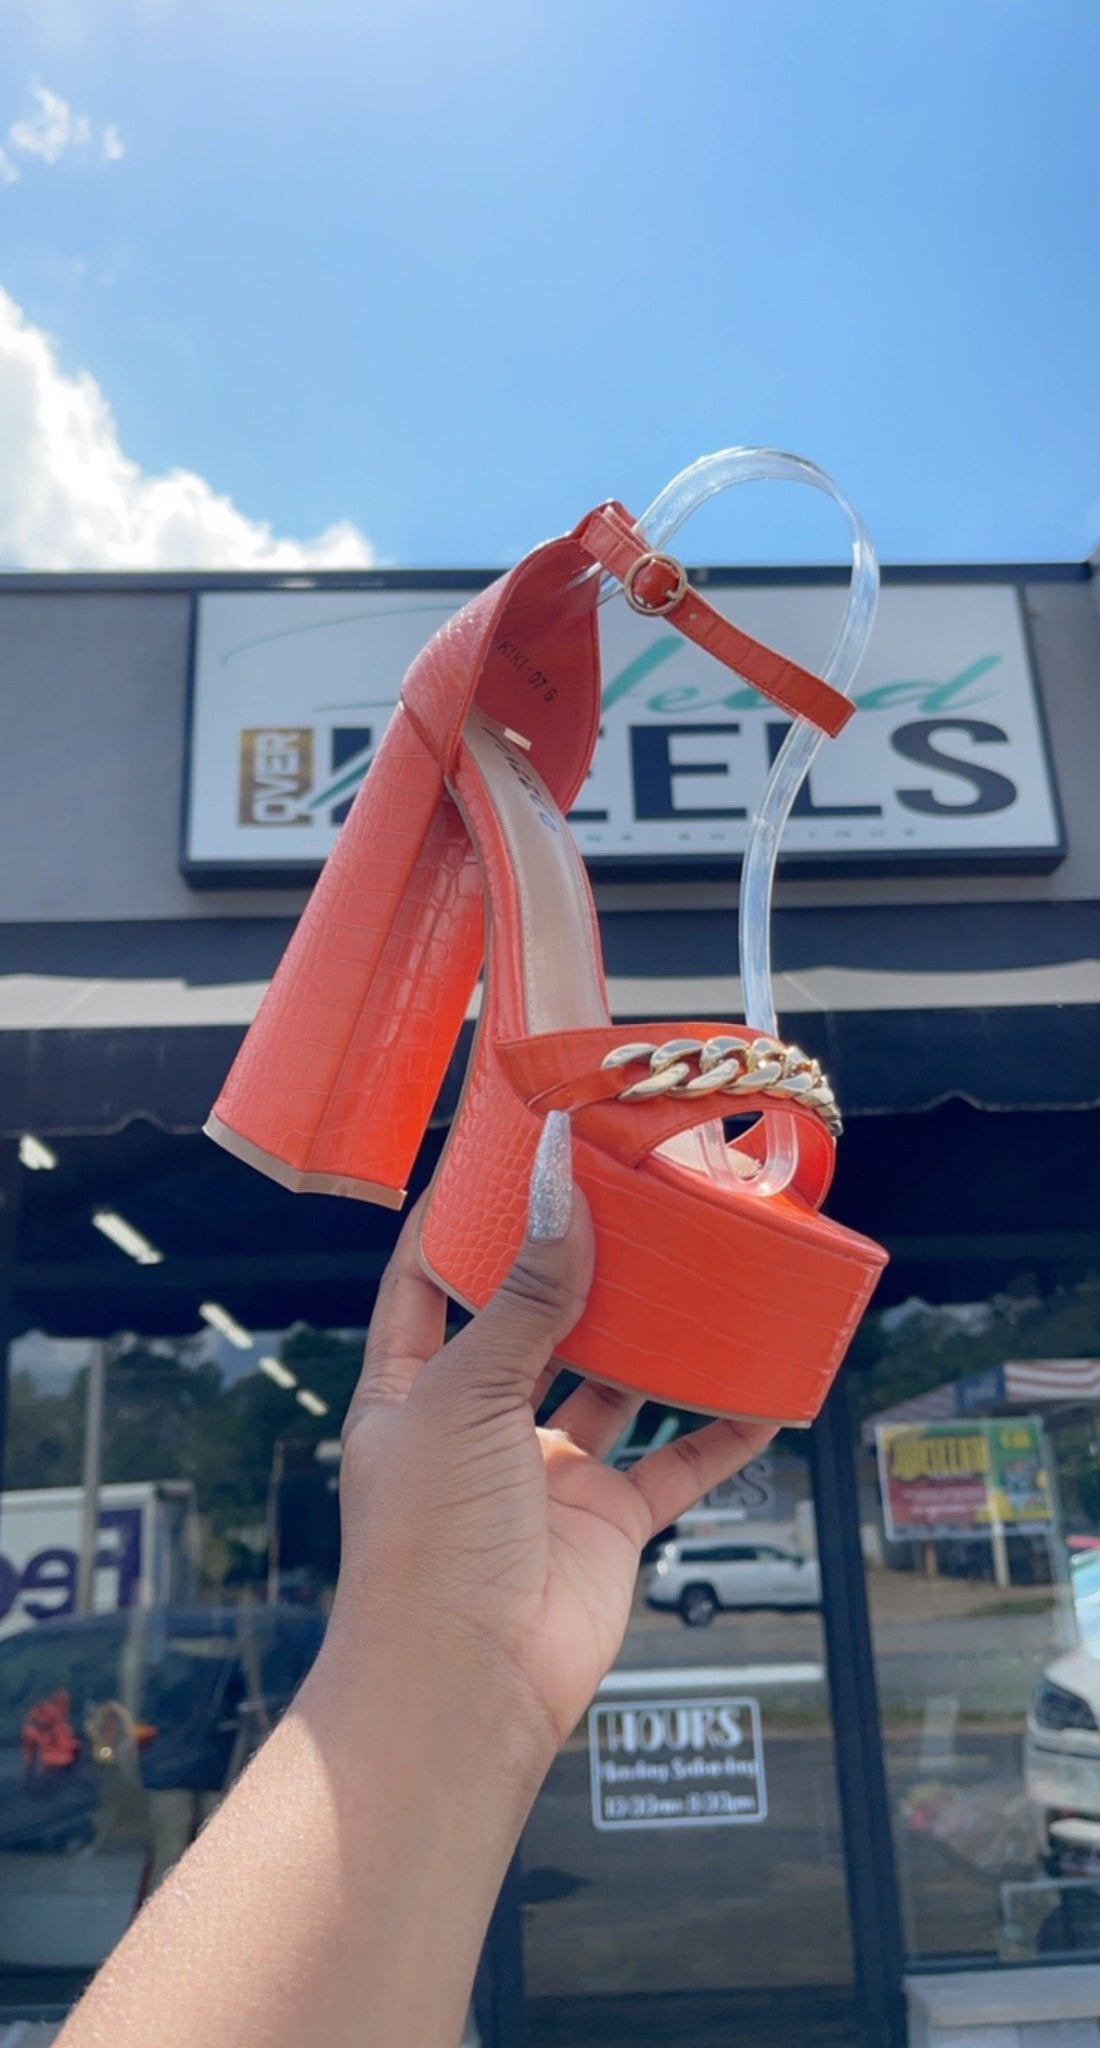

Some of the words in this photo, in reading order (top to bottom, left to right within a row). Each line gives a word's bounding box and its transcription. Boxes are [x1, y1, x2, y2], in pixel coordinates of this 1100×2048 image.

[498, 640, 548, 690] KIKI-07
[252, 732, 300, 823] OVER
[331, 718, 1018, 826] ELS
[606, 1707, 742, 1754] HOURS
